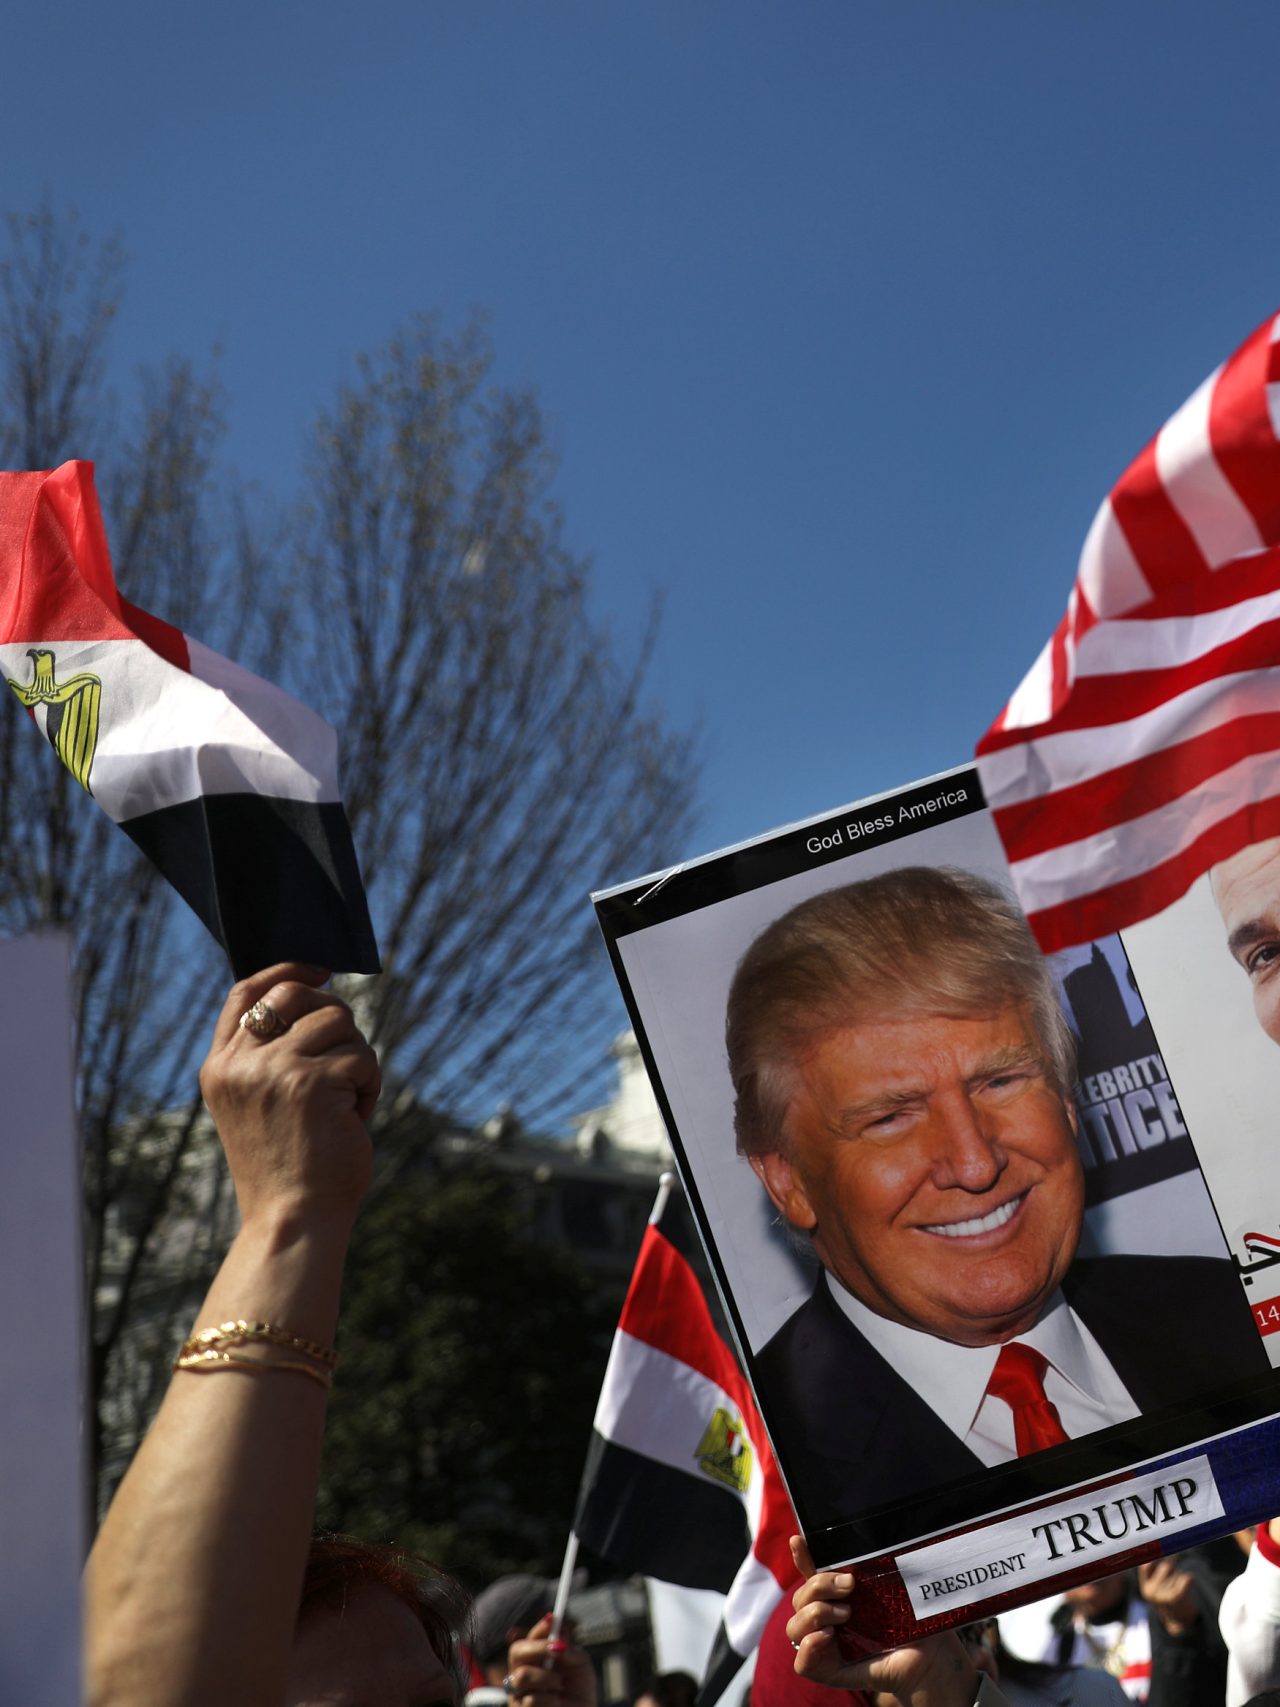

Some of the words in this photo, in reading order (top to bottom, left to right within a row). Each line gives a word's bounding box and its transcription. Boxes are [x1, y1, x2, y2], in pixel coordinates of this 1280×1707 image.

[806, 829, 843, 853] God
[846, 814, 894, 840] Bless
[898, 788, 968, 823] America
[920, 1552, 1026, 1600] PRESIDENT
[1032, 1477, 1197, 1561] TRUMP
